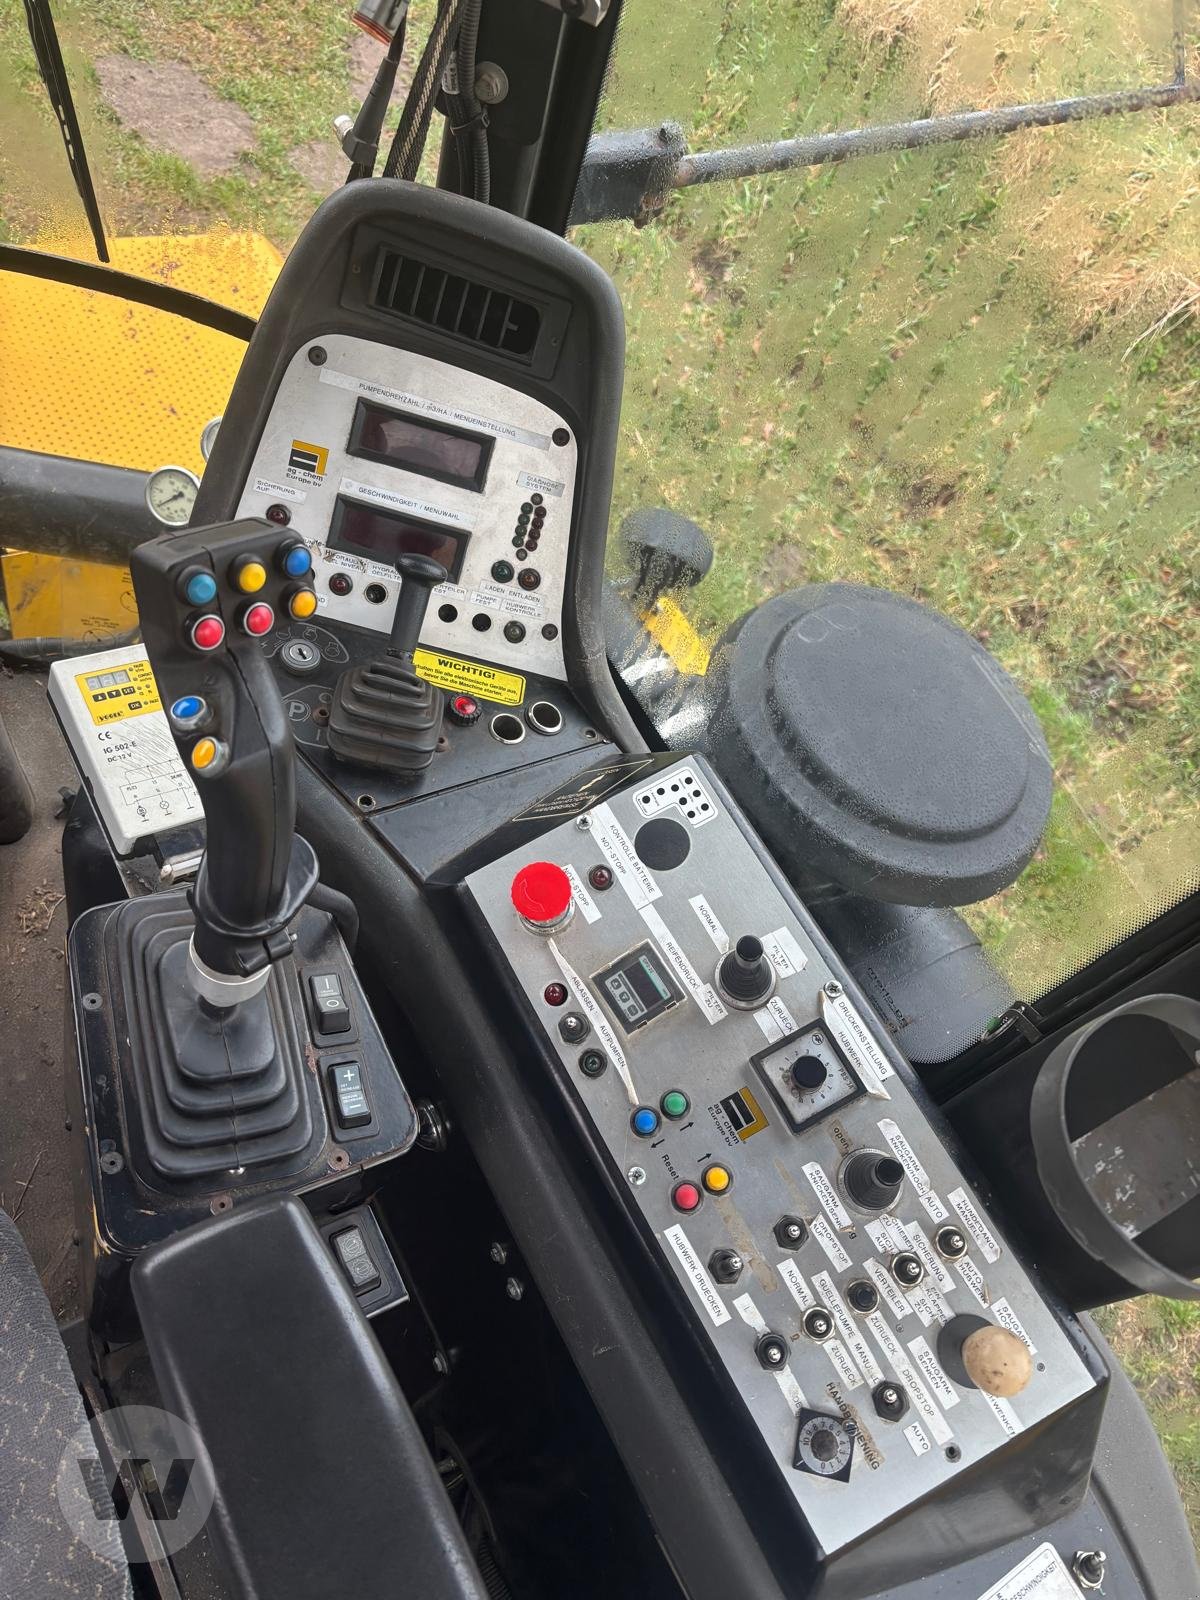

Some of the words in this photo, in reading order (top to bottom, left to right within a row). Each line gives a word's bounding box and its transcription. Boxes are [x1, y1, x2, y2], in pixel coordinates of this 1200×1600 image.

[358, 383, 420, 407] PUMPENDREHZAHL
[453, 413, 516, 436] MENUEINSTELLUNG
[256, 479, 296, 495] SICHERUNG
[285, 473, 312, 485] Europe
[302, 470, 323, 482] chem
[525, 481, 552, 492] SYSTEM
[526, 475, 559, 489] DIAGNOSE
[357, 486, 418, 508] GESCHWINDIGKEIT
[423, 505, 461, 520] MENUWAHL
[372, 565, 398, 575] HYDRAU
[508, 590, 540, 603] ENTLADEN
[437, 658, 495, 679] WICHTIG!
[114, 740, 137, 751] 502-E
[599, 836, 627, 875] NOT-STOPP
[608, 823, 635, 862] KONTROLLE
[631, 861, 655, 894] BATTERIE
[664, 940, 698, 989] REIFENDRUCK
[769, 952, 782, 968] AUF
[771, 944, 789, 970] FILTER
[705, 989, 724, 1014] FILTER
[769, 998, 794, 1033] ZURUECK
[570, 975, 595, 1012] ABLASSEN
[598, 1024, 627, 1067] AUFPUMPEN
[837, 1000, 888, 1076] DRUCKEINSTELLUNG
[836, 1030, 863, 1068] HUBWERK
[706, 1106, 726, 1136] Europe
[724, 1136, 733, 1148] bv
[712, 1102, 723, 1115] ag
[723, 1120, 740, 1145] chem
[831, 1126, 850, 1150] open
[661, 1153, 680, 1180] Reset
[889, 1136, 926, 1194] KNICKEN/HOCH
[894, 1133, 920, 1172] SAUGARM
[813, 1168, 839, 1209] SAUGARM
[924, 1194, 943, 1219] AUTO
[882, 1215, 891, 1227] ZU
[890, 1217, 914, 1251] CHIEBER
[955, 1201, 981, 1240] MANUELL
[961, 1198, 995, 1249] HUNDEGANG
[817, 1220, 848, 1265] DROPSTOP
[912, 1233, 945, 1282] SICHERUNG
[671, 1232, 698, 1272] HUBWERK
[693, 1272, 723, 1317] DRUECKEN
[785, 1269, 810, 1306] NORMAL
[873, 1267, 905, 1313] VERTEILER
[963, 1260, 982, 1285] AUTO
[817, 1278, 855, 1338] GUELLEPUMPE
[912, 1300, 924, 1314] ZU
[830, 1345, 858, 1386] ZURUECK
[870, 1315, 898, 1356] ZURUECK
[901, 1368, 935, 1418] DROPSTOP
[916, 1353, 941, 1390] SENKEN
[922, 1350, 951, 1395] SAUGARM
[824, 1381, 881, 1470] HANDBIENING
[910, 1423, 930, 1451] AUTO
